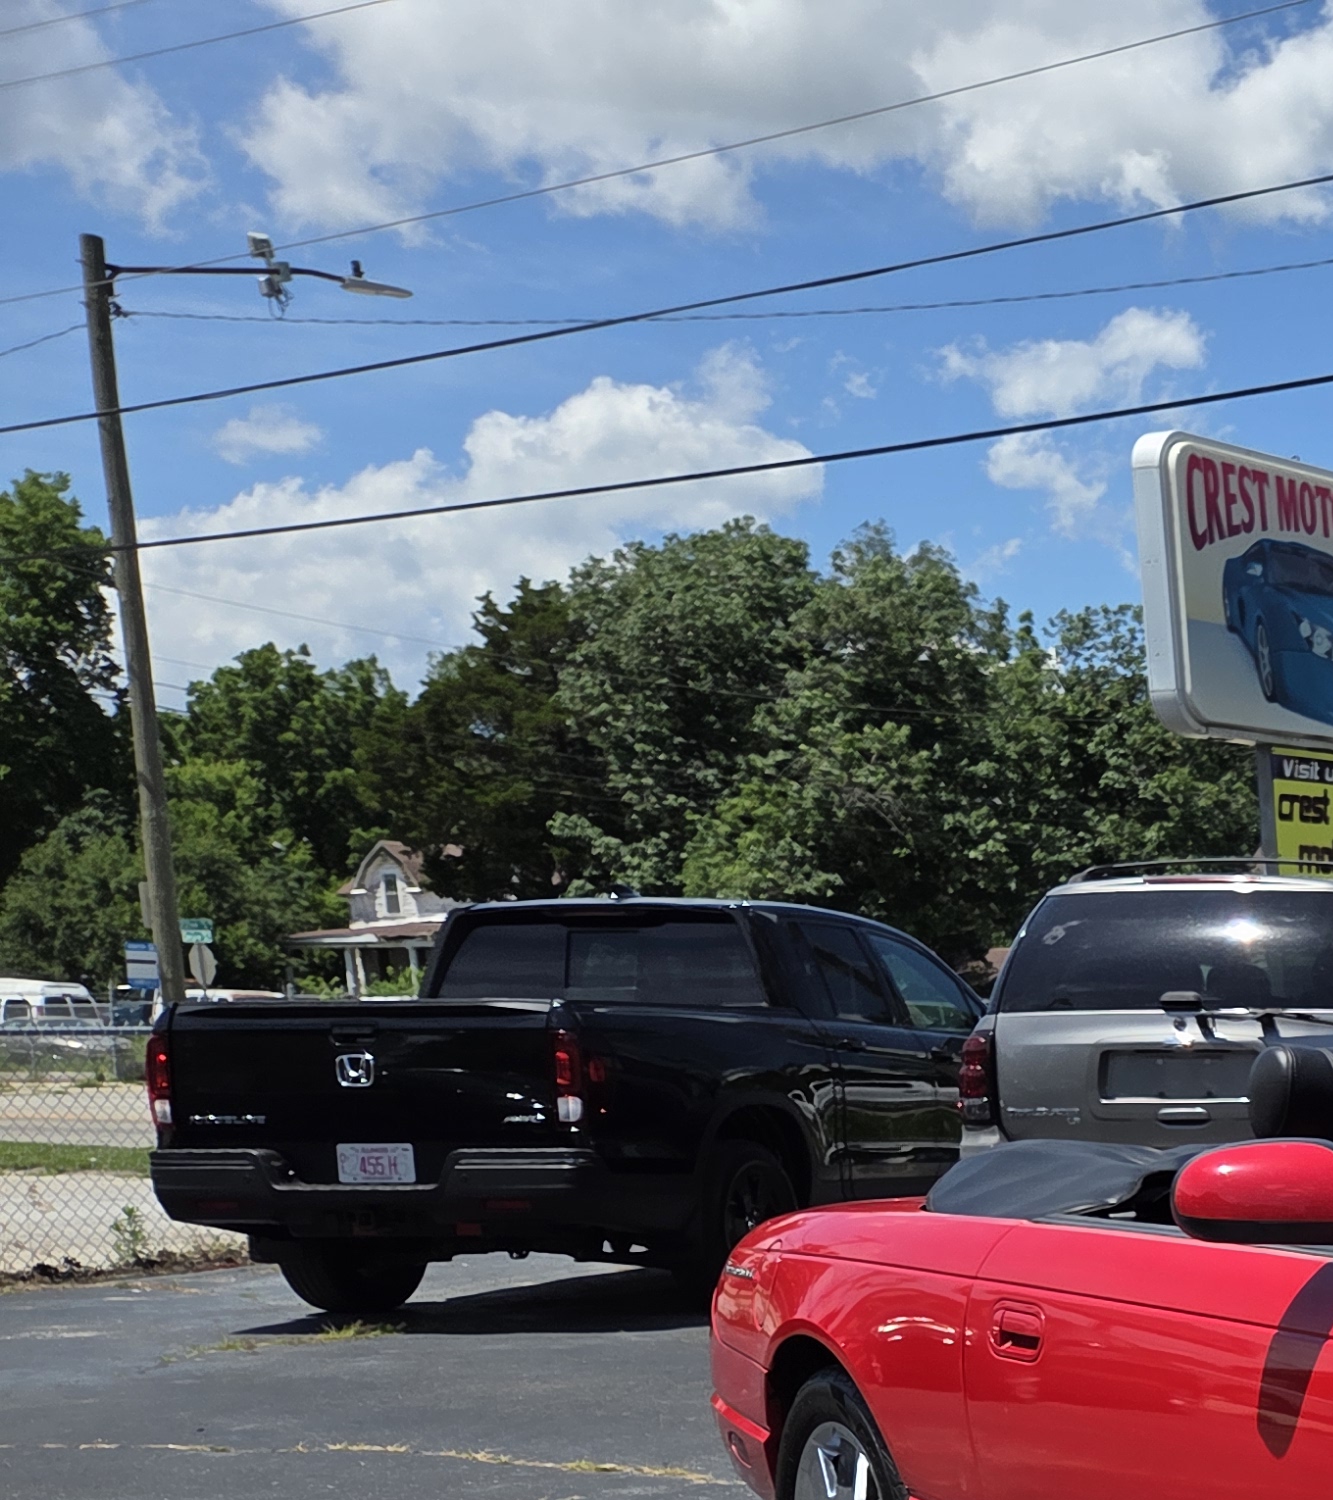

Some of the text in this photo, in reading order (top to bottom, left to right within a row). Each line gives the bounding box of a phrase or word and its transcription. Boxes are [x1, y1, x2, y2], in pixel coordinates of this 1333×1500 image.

[1186, 453, 1270, 552] CREST
[1282, 759, 1321, 780] Visit
[1278, 788, 1331, 825] crest
[360, 1155, 385, 1176] 455
[387, 1154, 400, 1176] H
